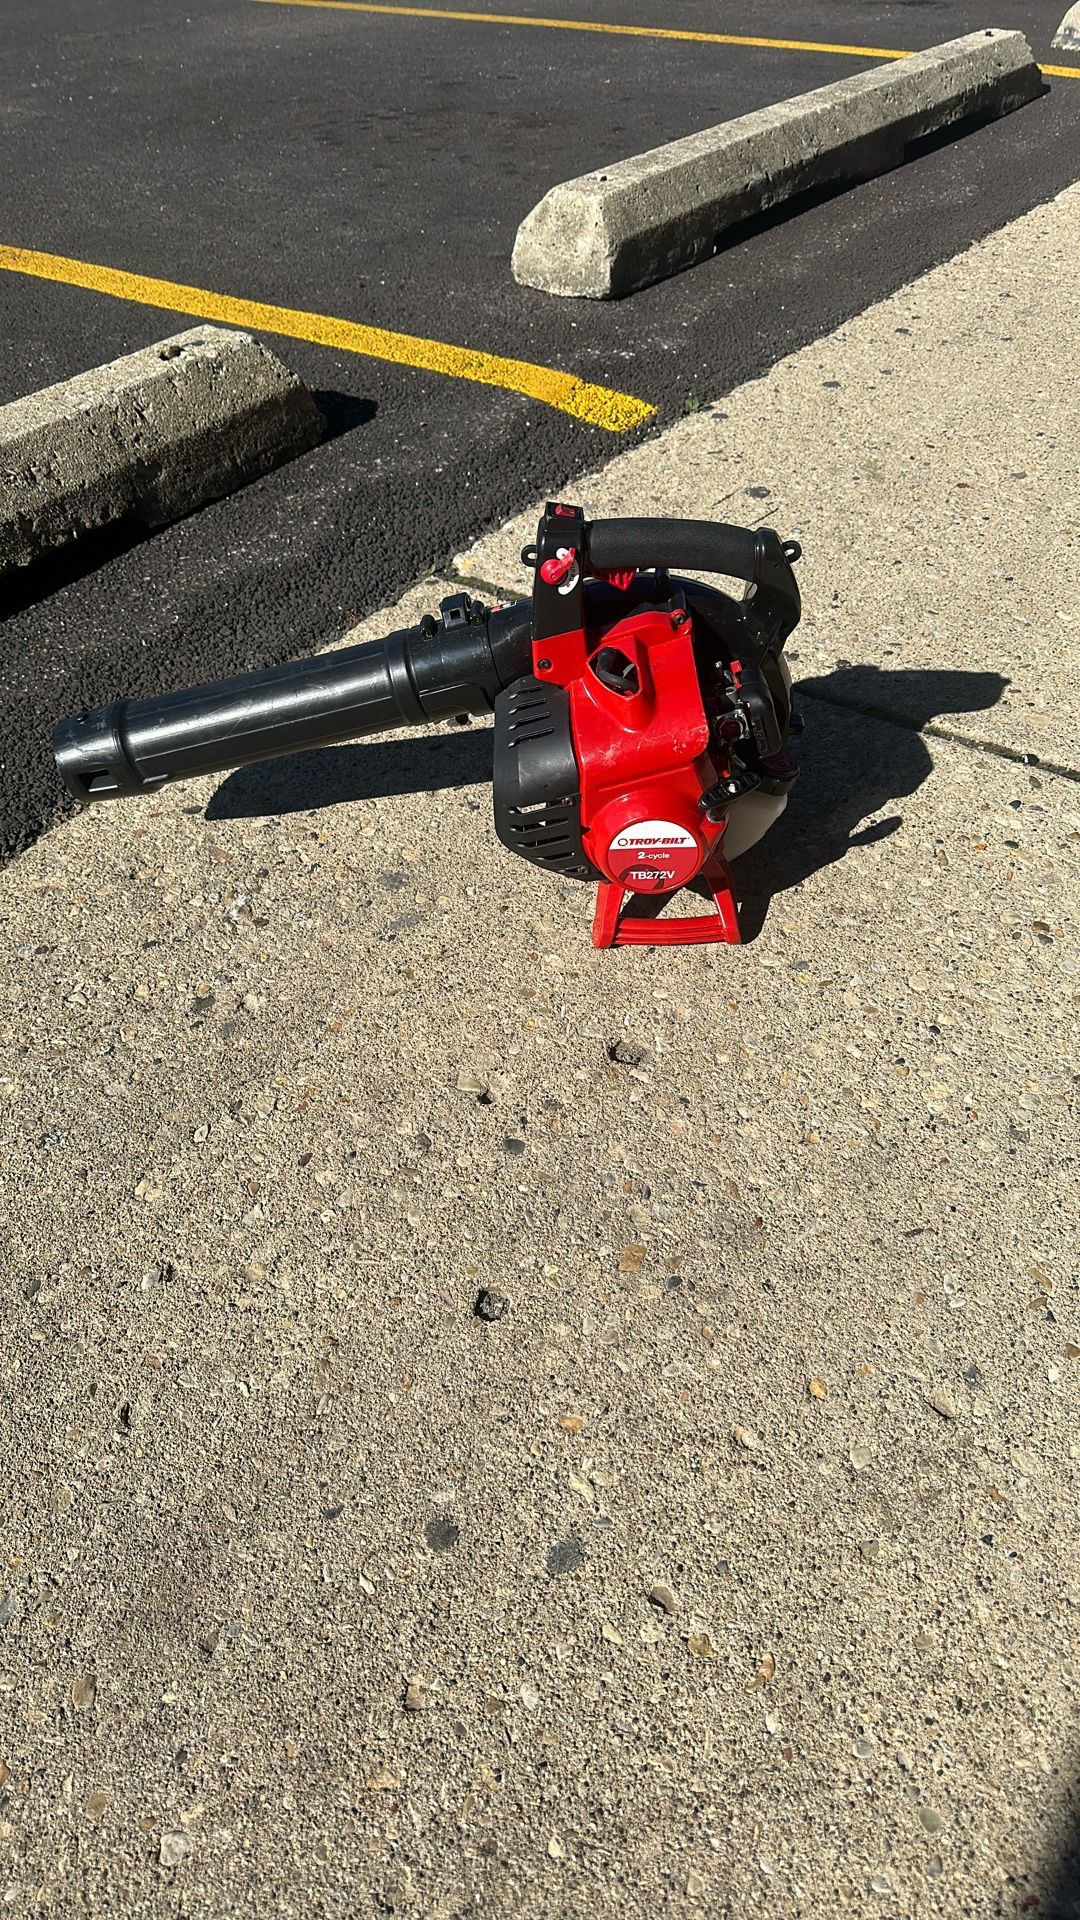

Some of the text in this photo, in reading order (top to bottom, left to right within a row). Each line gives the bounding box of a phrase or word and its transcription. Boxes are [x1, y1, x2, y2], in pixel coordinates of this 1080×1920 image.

[629, 837, 687, 846] TROY-BILT
[637, 851, 670, 860] 2-cycle
[630, 870, 675, 880] TB272V
